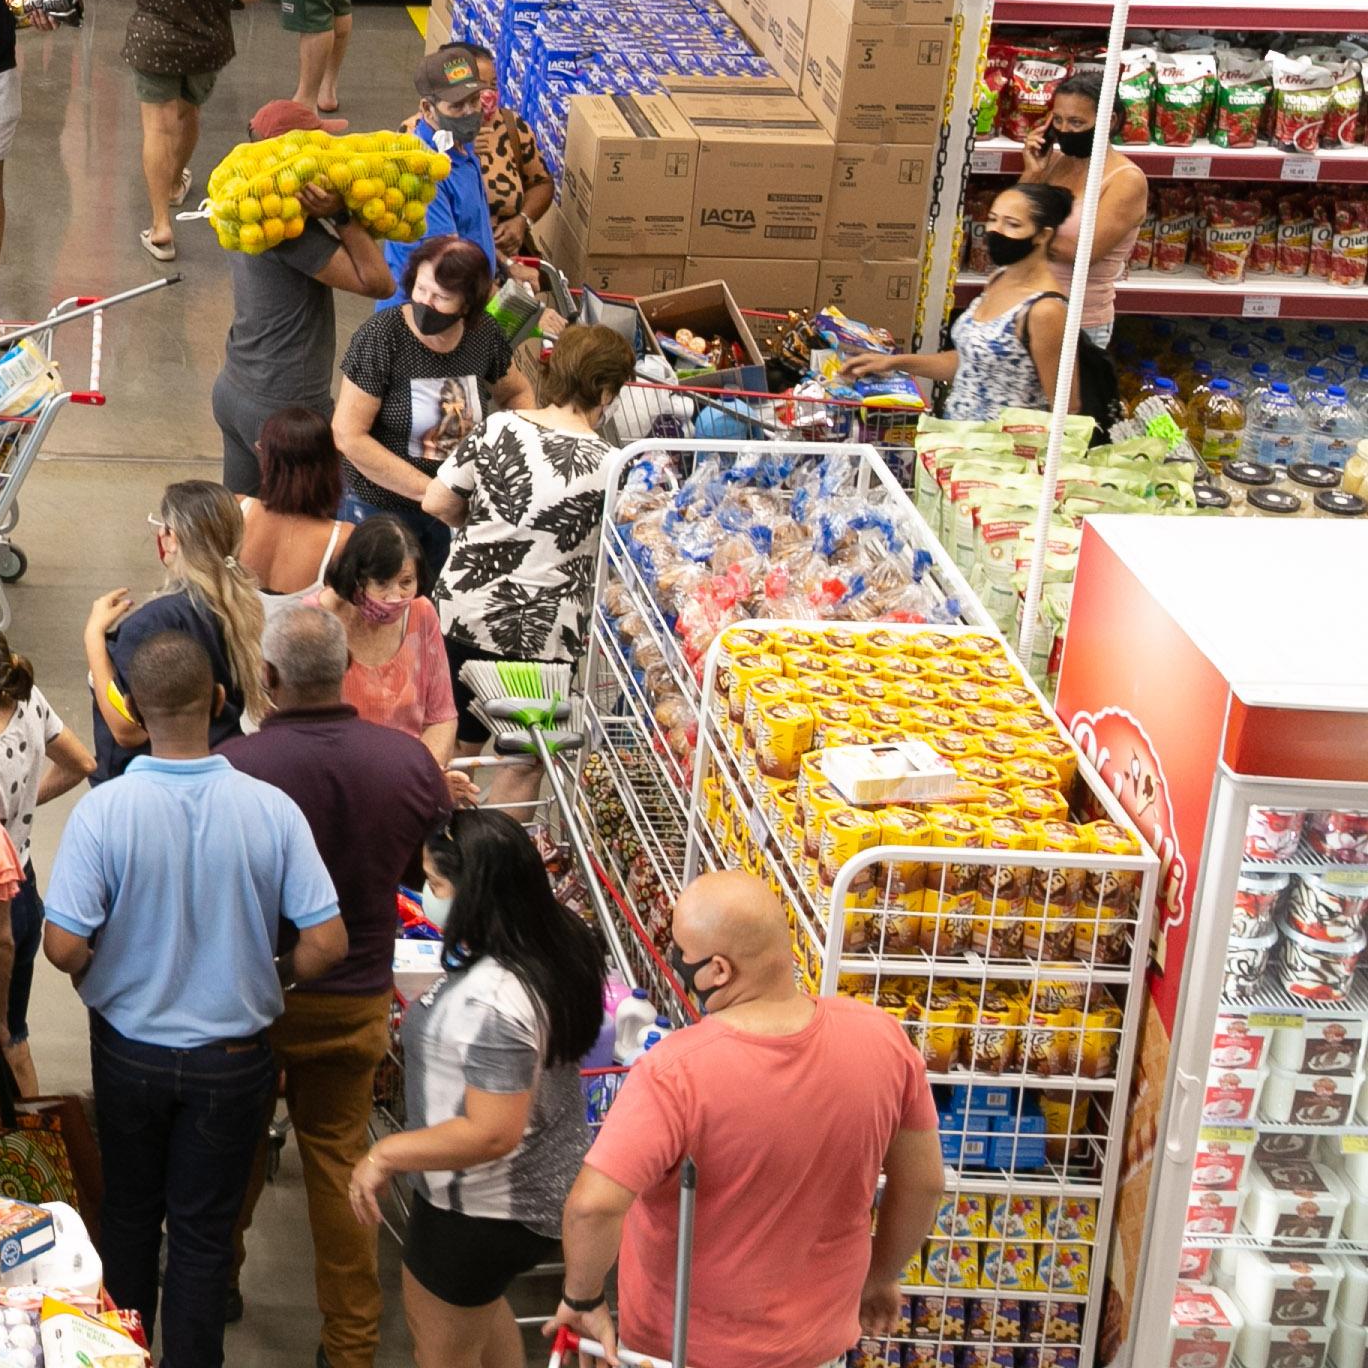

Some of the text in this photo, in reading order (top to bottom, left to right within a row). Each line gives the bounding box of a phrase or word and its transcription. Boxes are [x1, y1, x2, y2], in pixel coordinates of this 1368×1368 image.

[864, 48, 872, 62] 5
[548, 60, 575, 70] LACTA
[613, 161, 620, 175] 5
[846, 167, 853, 180] 5
[700, 208, 756, 227] LACTA
